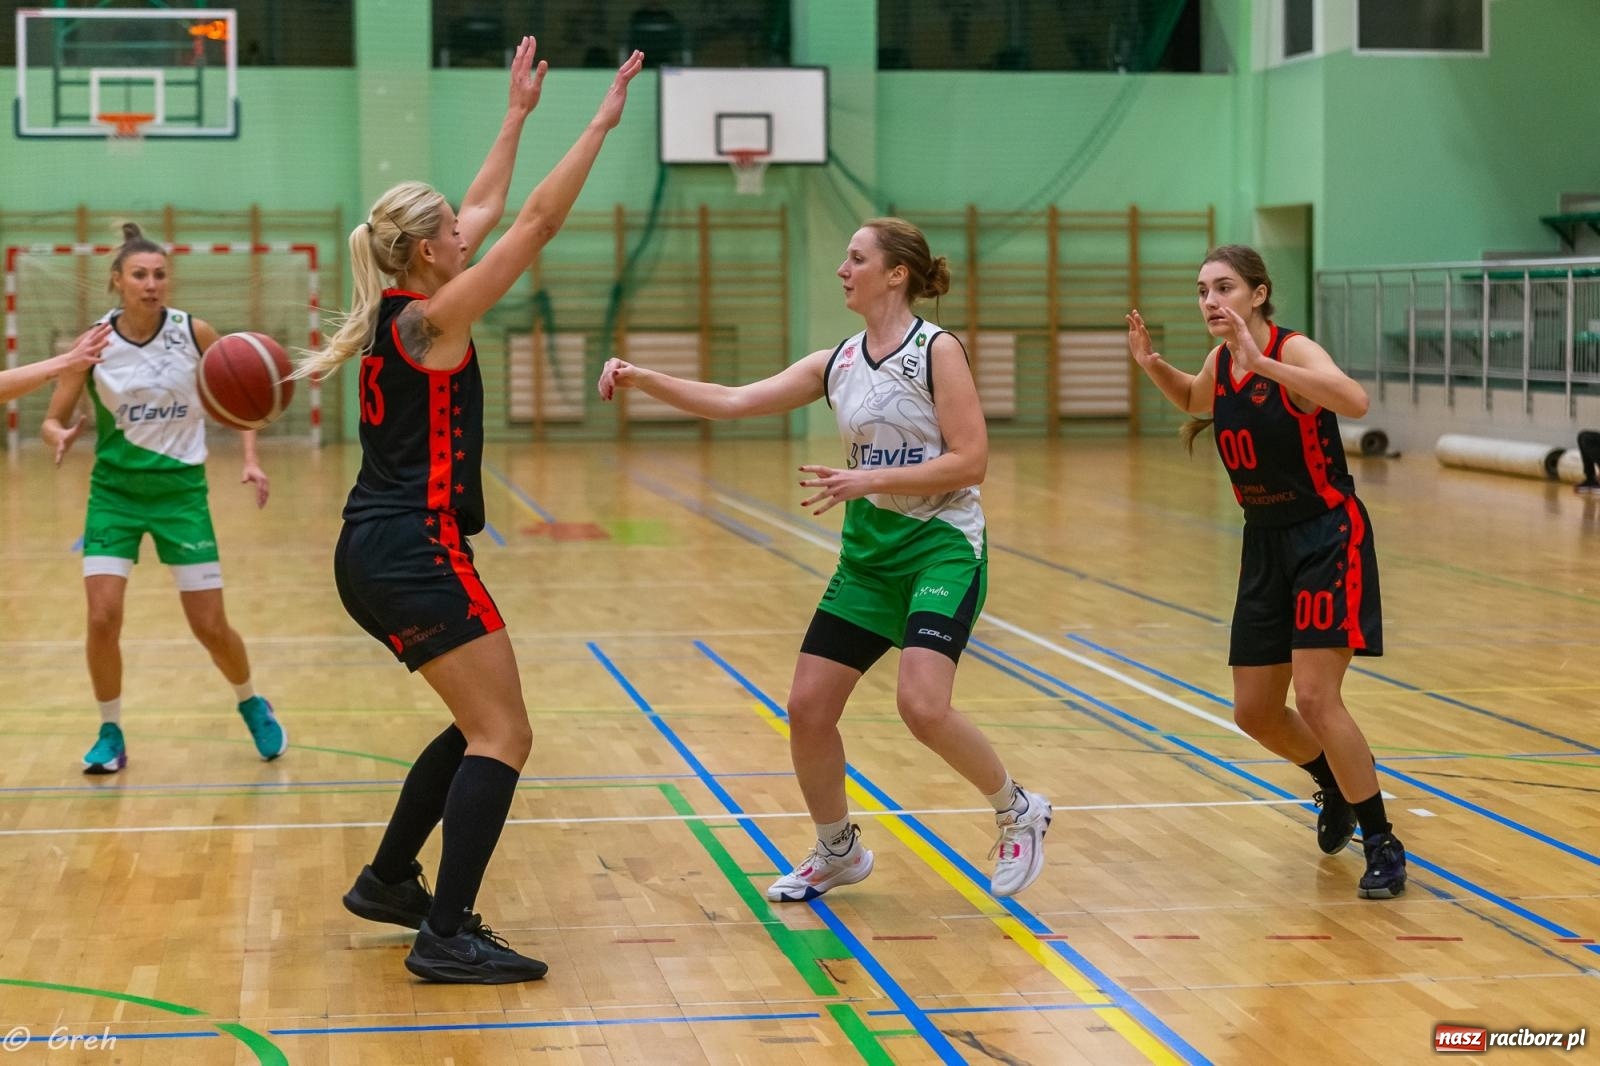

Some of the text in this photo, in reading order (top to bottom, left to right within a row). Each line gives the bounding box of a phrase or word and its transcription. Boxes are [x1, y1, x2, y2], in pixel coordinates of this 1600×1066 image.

[128, 401, 189, 422] Clavis
[860, 442, 924, 466] Clavis
[1219, 428, 1257, 470] 00
[1295, 589, 1334, 631] 00
